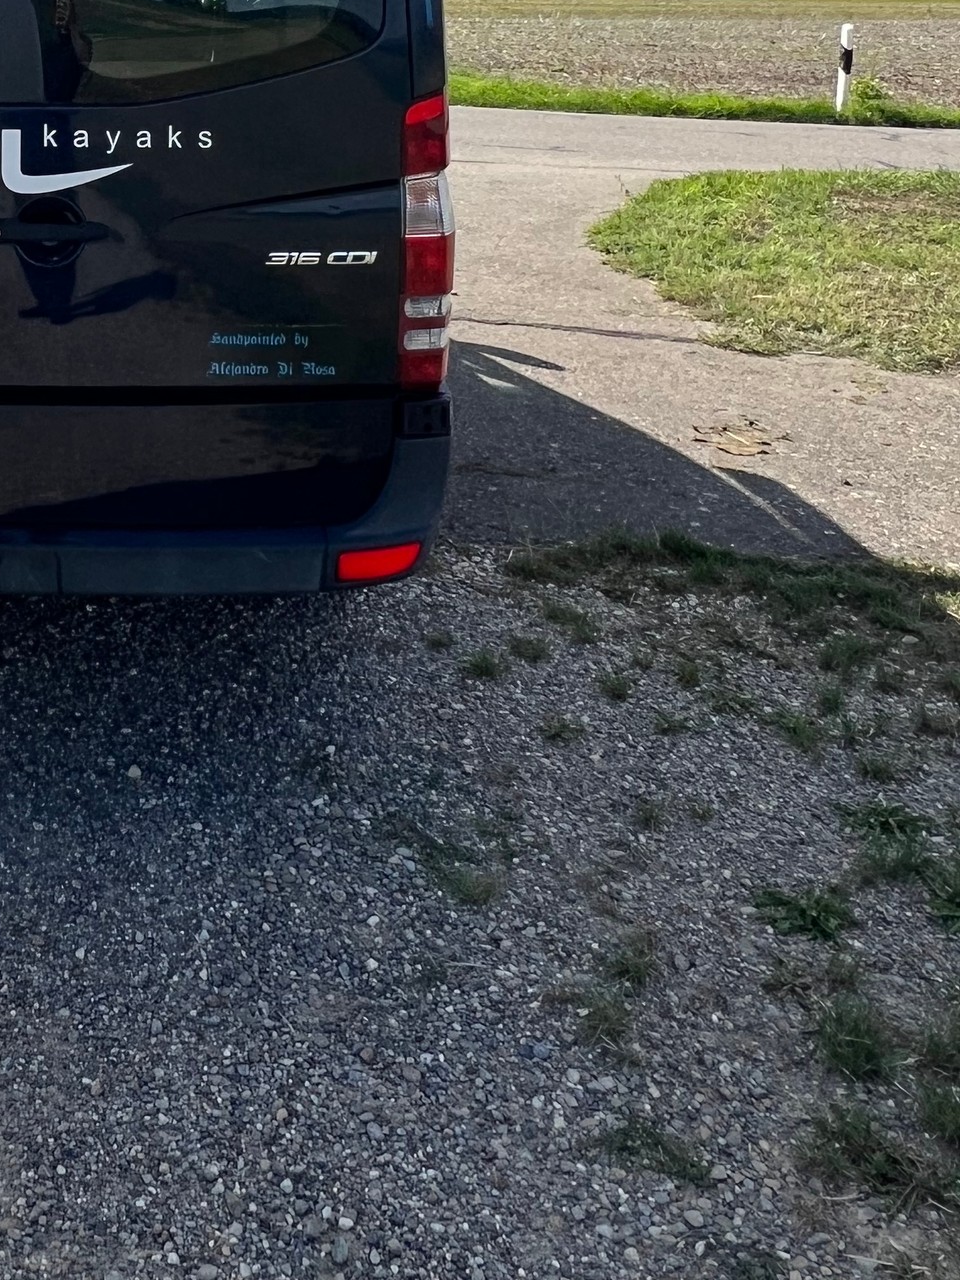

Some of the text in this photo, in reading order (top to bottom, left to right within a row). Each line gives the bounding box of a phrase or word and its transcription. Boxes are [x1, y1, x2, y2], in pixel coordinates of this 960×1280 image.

[43, 124, 214, 154] kayaks
[265, 251, 378, 265] 316 CDI
[294, 332, 309, 348] by
[207, 361, 336, 377] Alejandro Di Rosa
